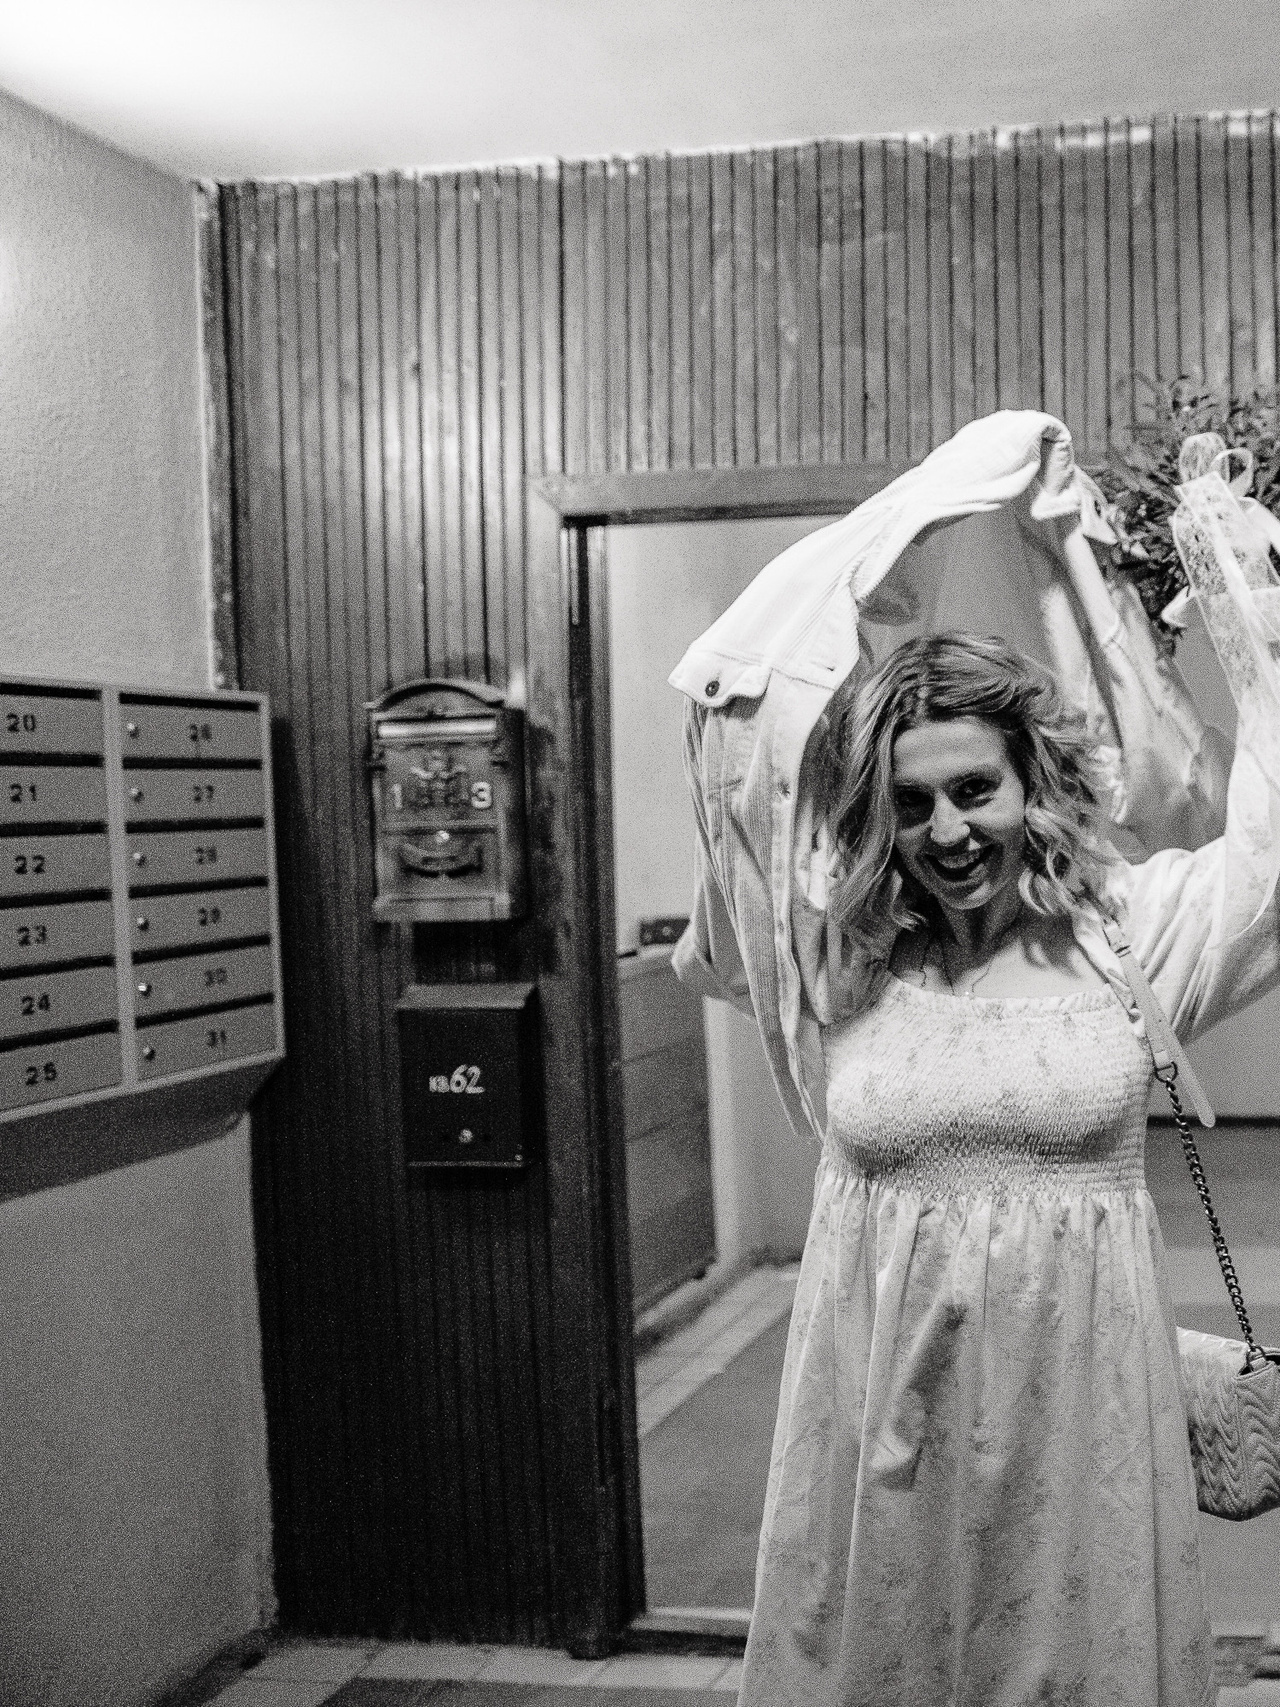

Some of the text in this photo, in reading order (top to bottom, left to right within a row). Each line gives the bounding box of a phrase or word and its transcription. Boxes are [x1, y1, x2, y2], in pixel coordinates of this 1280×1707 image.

[6, 713, 36, 733] 20
[9, 783, 37, 803] 21
[193, 784, 214, 803] 27
[471, 781, 492, 809] 3
[14, 854, 45, 875] 22
[17, 925, 46, 946] 23
[204, 967, 227, 987] 30
[21, 993, 50, 1016] 24
[206, 1030, 227, 1050] 31
[25, 1061, 57, 1086] 25
